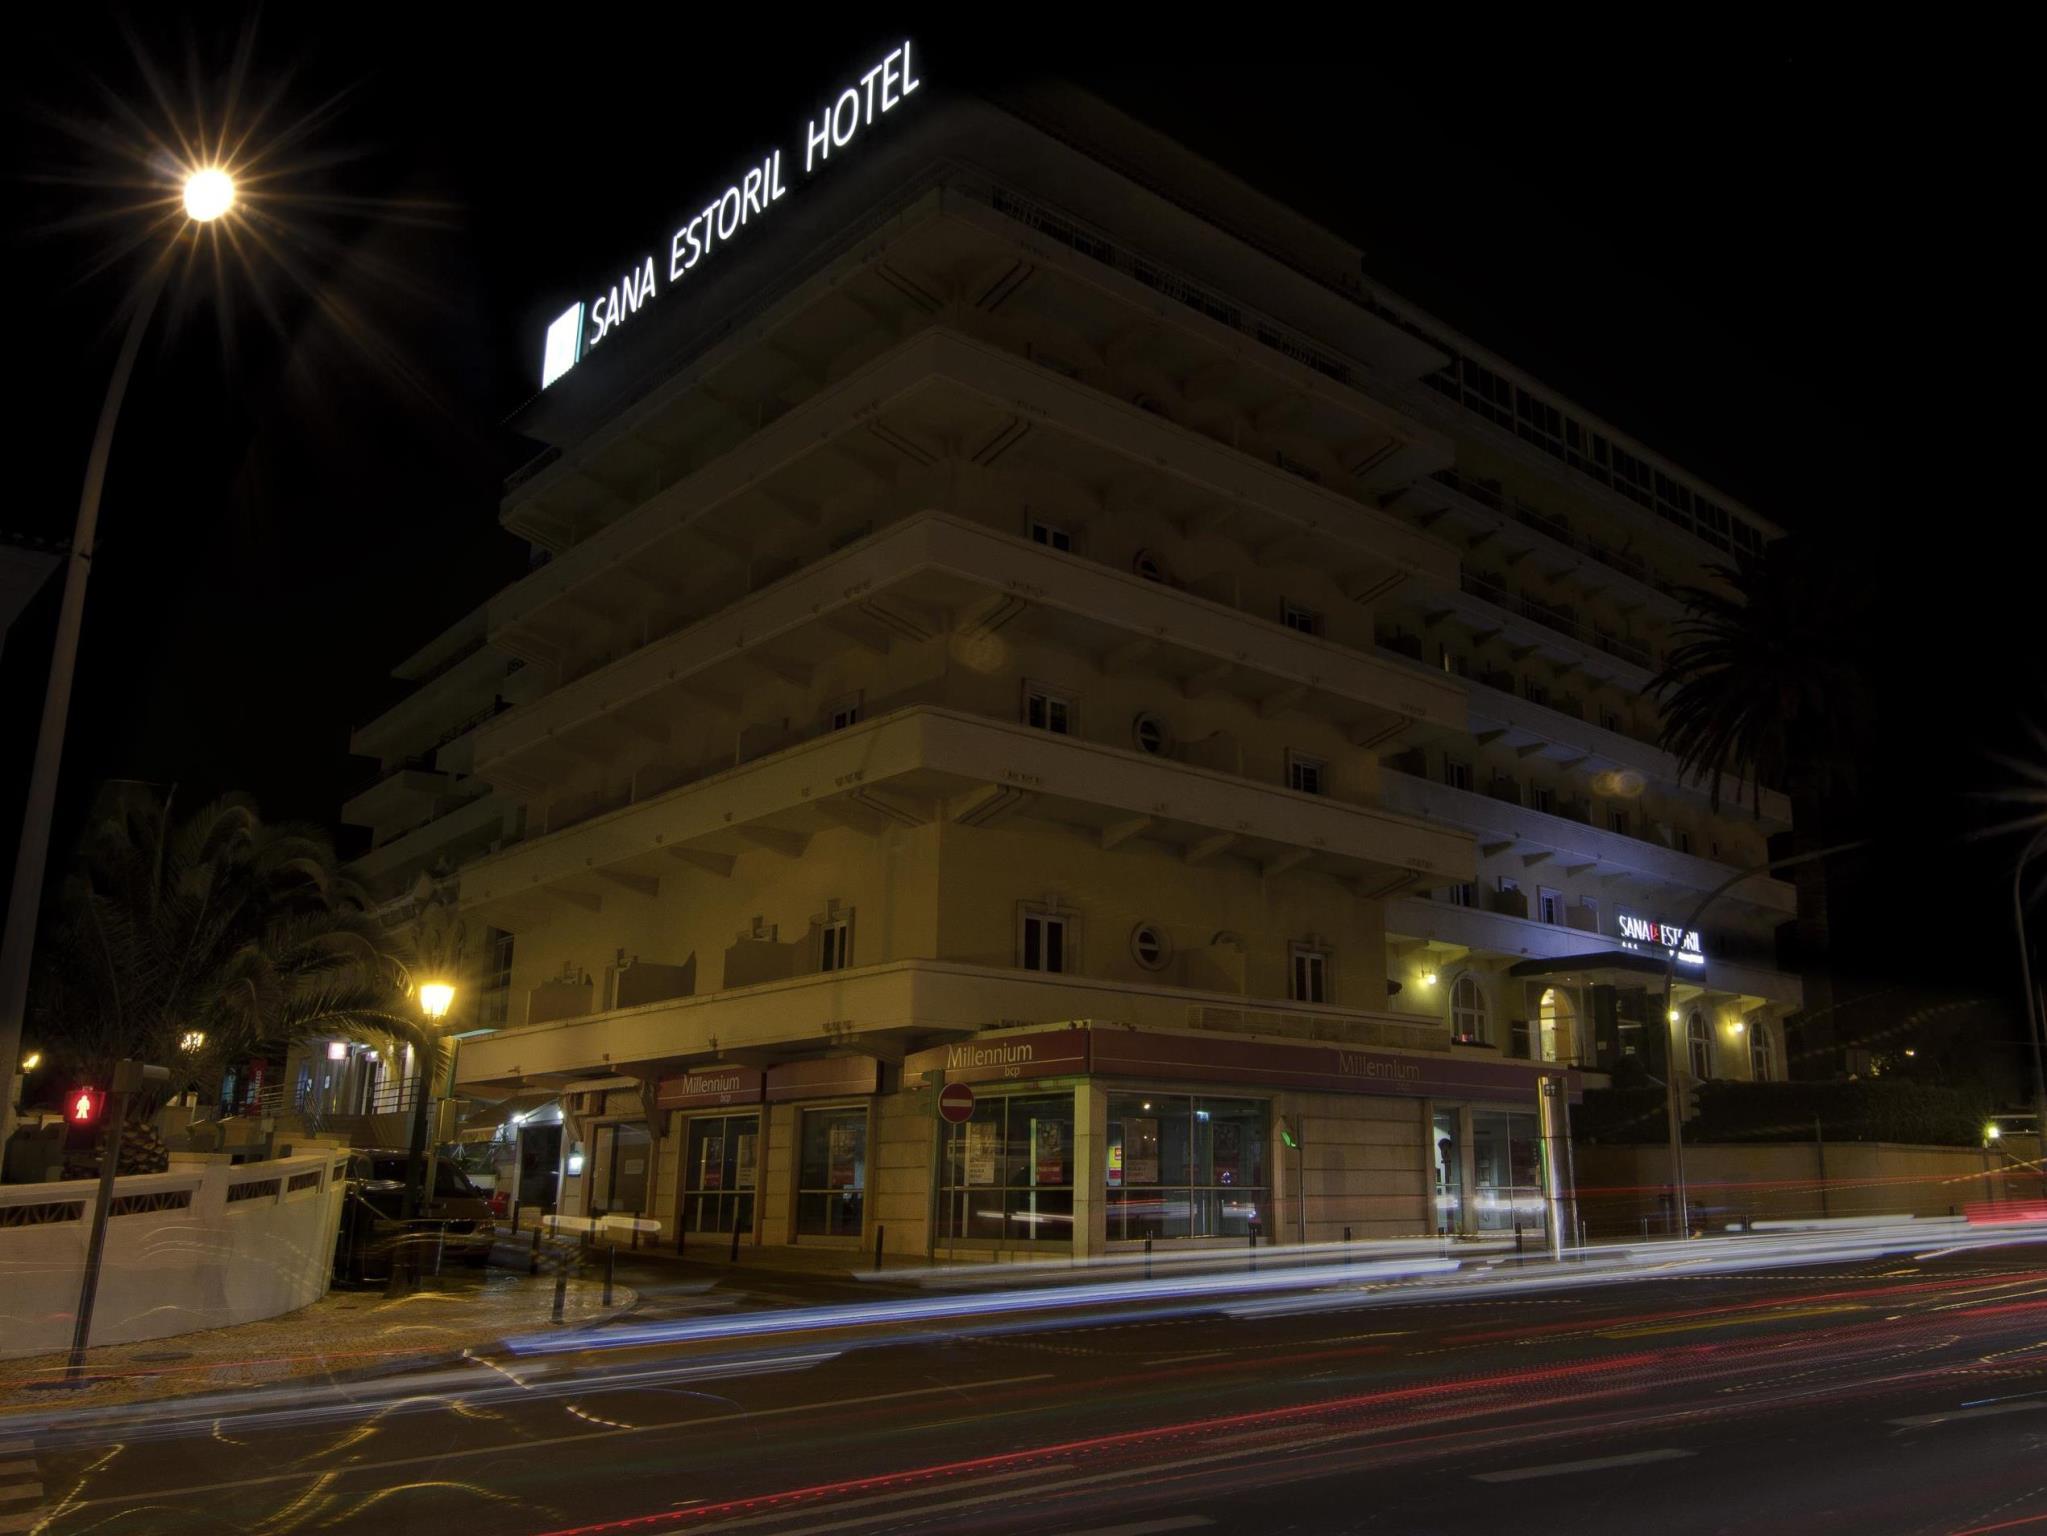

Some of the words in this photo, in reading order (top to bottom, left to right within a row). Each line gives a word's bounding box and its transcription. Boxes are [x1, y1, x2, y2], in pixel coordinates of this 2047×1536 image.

[590, 256, 656, 345] SANA
[670, 150, 786, 282] ESTORIL
[806, 40, 919, 173] HOTEL
[1619, 914, 1650, 942] SANA
[946, 1042, 1033, 1070] Millennium
[1338, 1049, 1420, 1081] Millennium
[681, 1074, 741, 1095] Millennium
[1004, 1064, 1020, 1078] bcp
